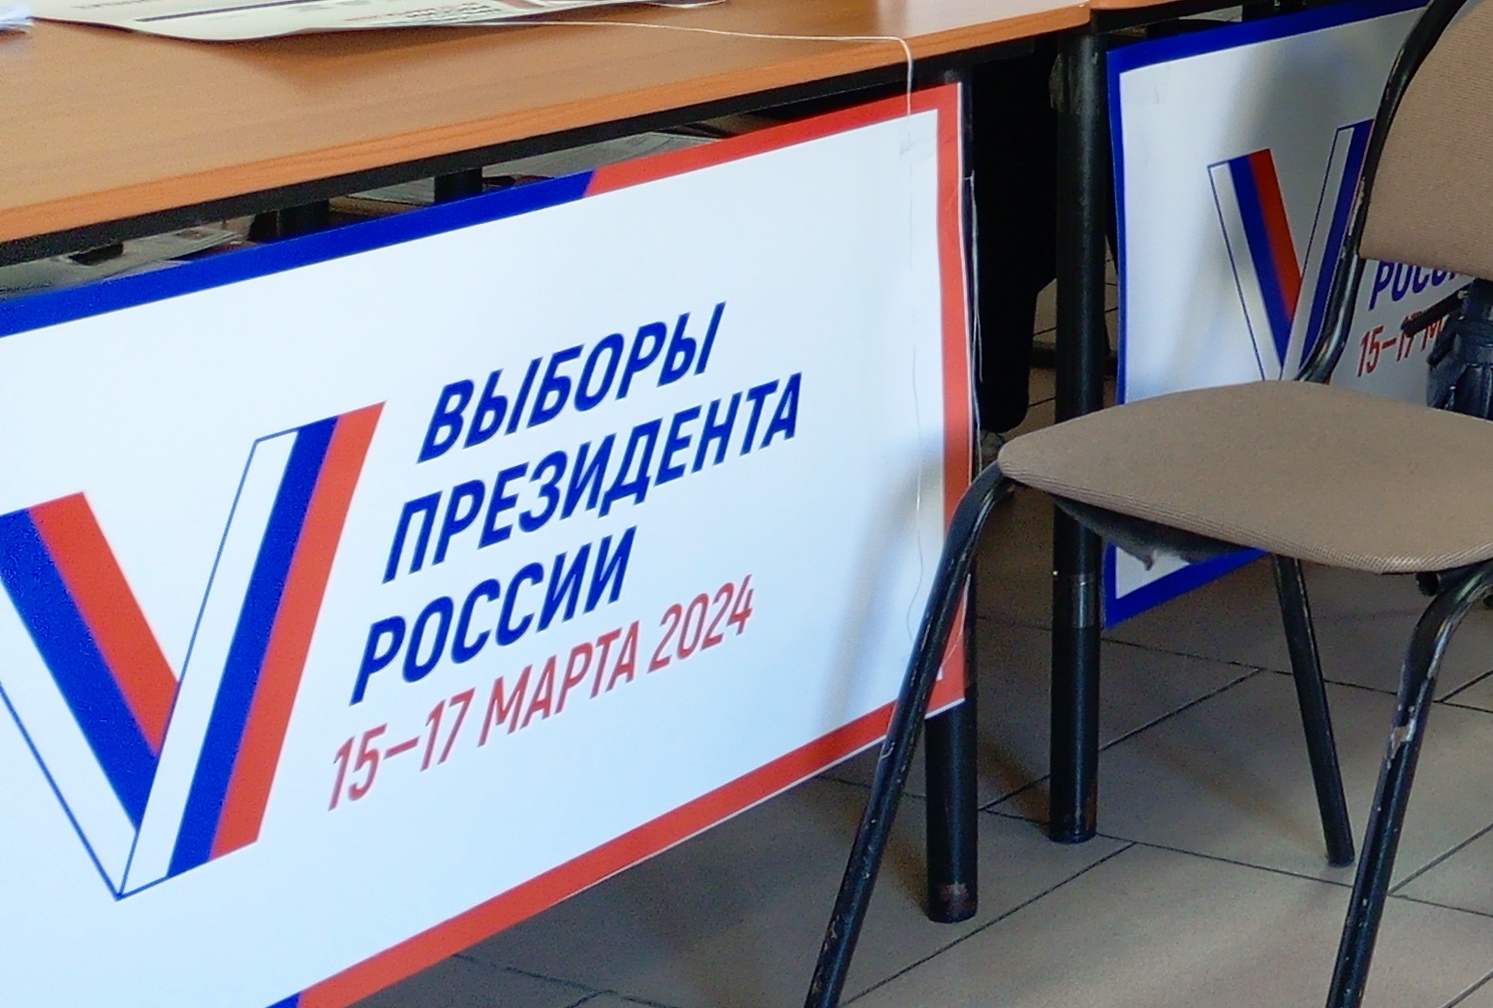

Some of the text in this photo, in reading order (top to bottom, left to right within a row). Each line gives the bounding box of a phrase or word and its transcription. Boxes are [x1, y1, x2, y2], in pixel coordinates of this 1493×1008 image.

[382, 372, 802, 584] ПРЕЗИДЕНТА
[416, 301, 726, 463] ВЫБОРЫ
[327, 574, 753, 812] 15–17 МАРТА 2024
[349, 526, 637, 706] РОССИИ
